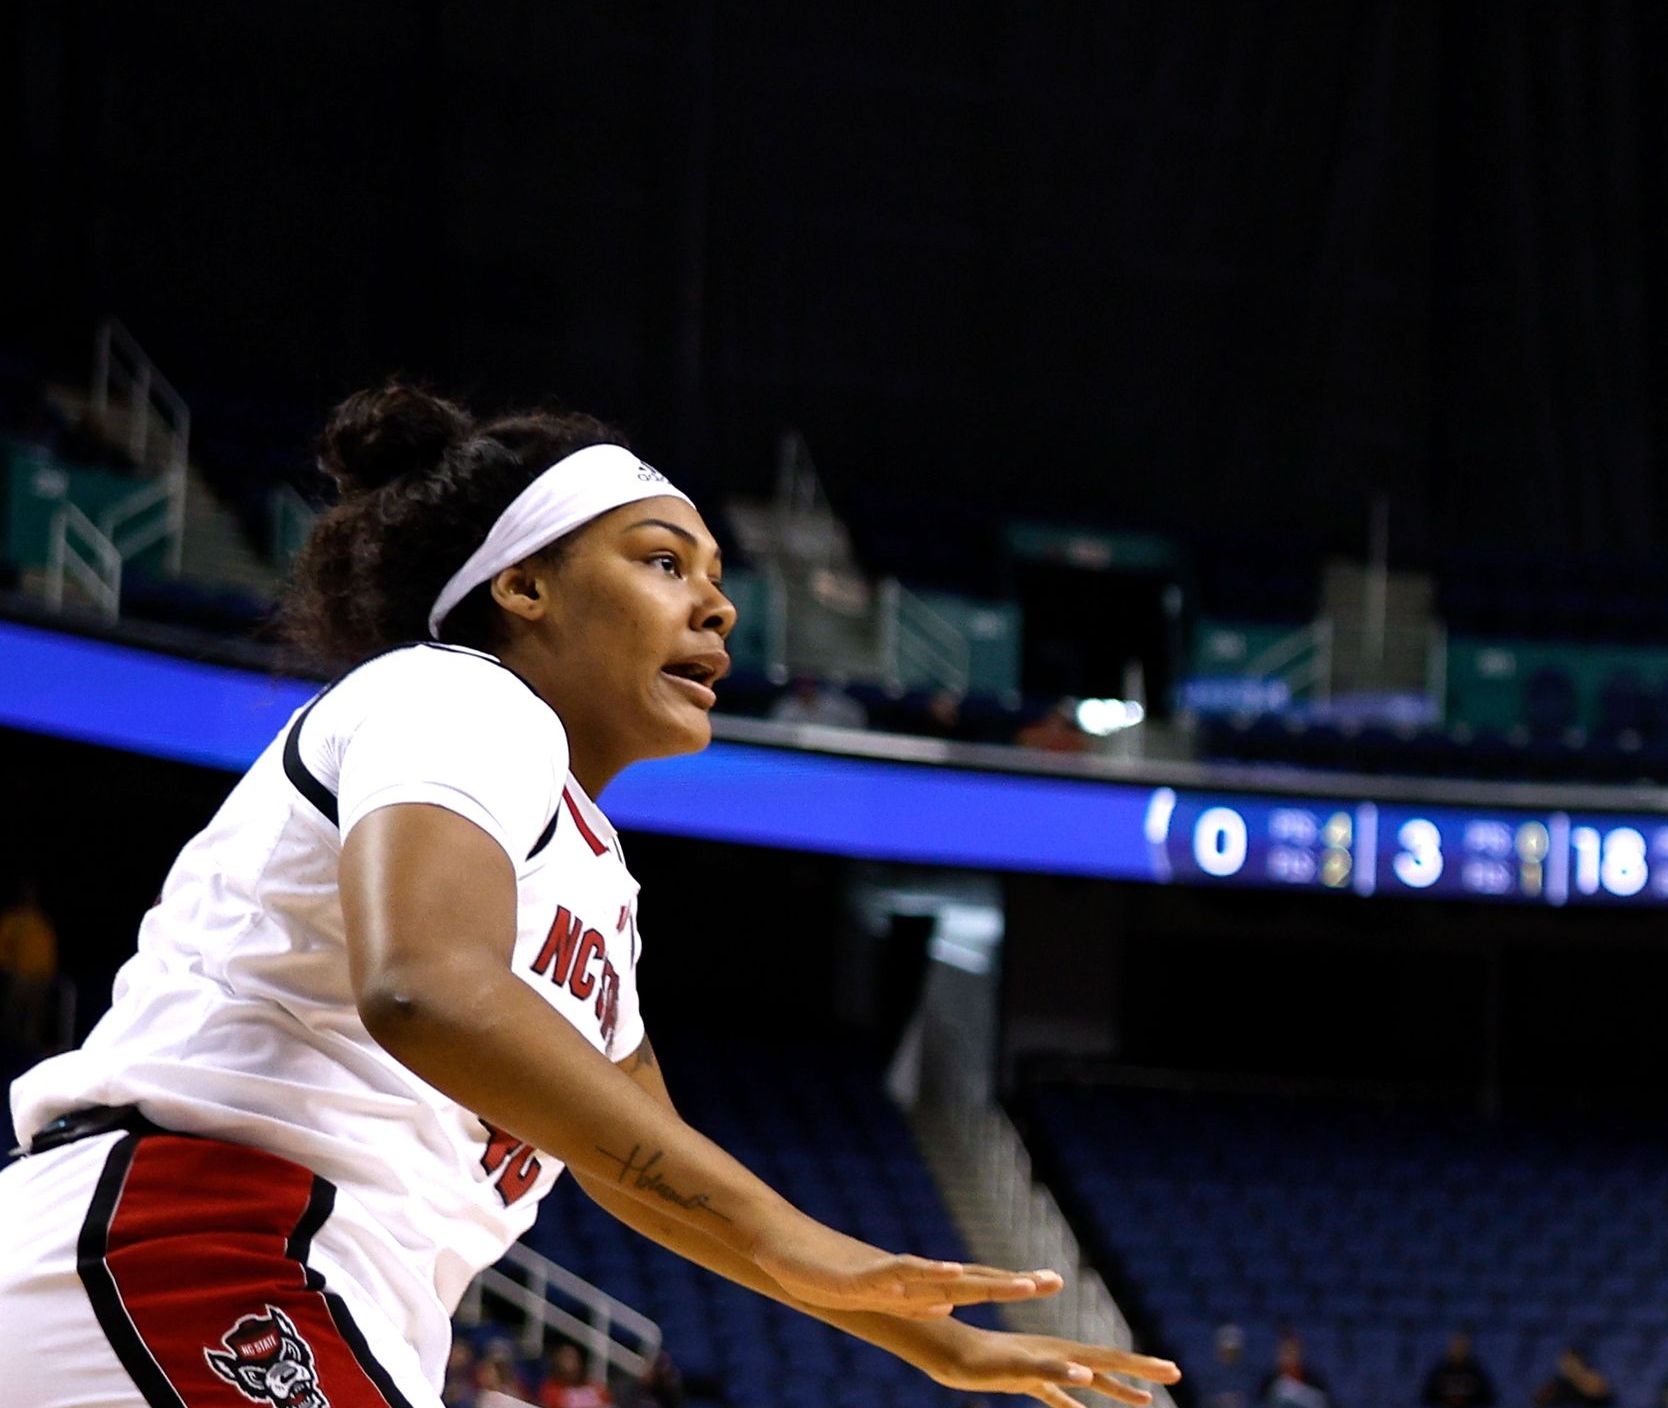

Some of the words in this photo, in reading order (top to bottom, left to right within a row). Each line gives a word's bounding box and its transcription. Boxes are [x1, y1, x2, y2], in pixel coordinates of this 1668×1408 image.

[1194, 806, 1248, 876] 0
[1393, 818, 1443, 888] 3
[1572, 825, 1649, 897] 18
[530, 904, 605, 1001] NC
